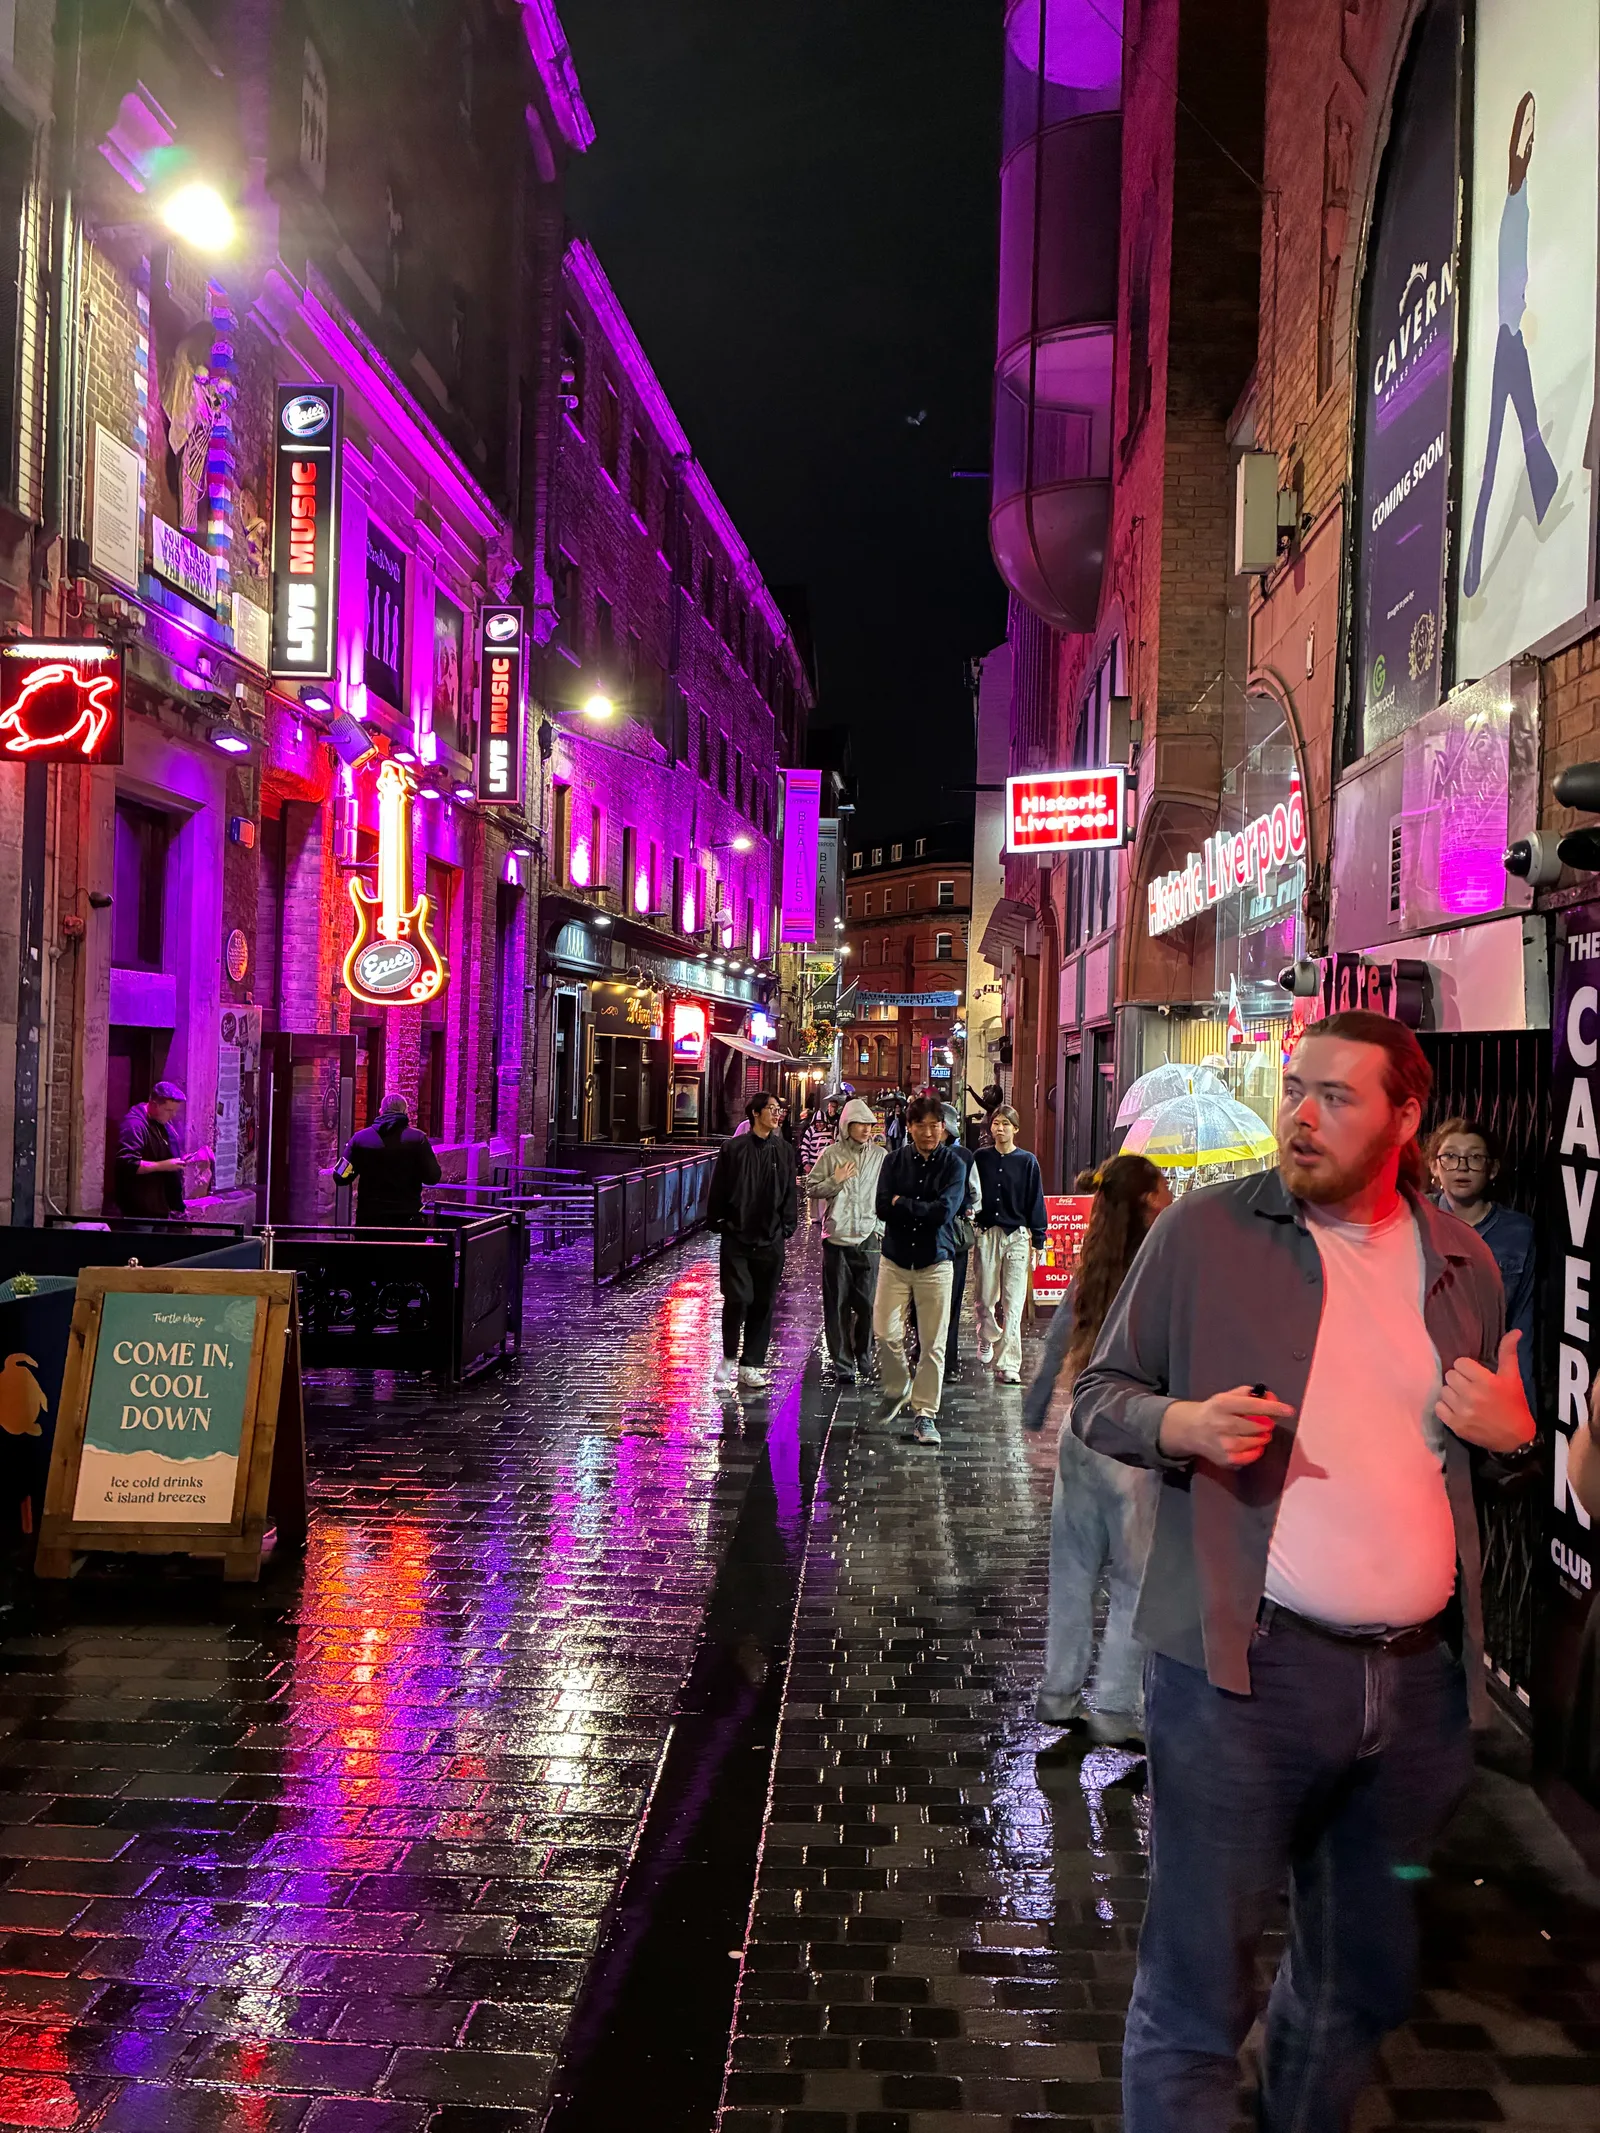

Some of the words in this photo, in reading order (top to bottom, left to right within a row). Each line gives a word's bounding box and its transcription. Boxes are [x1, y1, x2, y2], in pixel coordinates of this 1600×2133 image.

[1374, 253, 1453, 396] CAVERN
[1412, 327, 1438, 366] HOTEL
[1372, 470, 1411, 532] COMING
[1412, 431, 1445, 488] SOON
[290, 461, 317, 575] MUSIC
[162, 539, 180, 564] WHO
[184, 554, 212, 590] SHOOK
[164, 526, 185, 554] FOUR
[189, 540, 211, 571] LADS
[287, 583, 317, 662] LIVE
[490, 657, 510, 734] MUSIC
[489, 739, 508, 793] LIVE
[1014, 809, 1115, 834] Liverpool
[1021, 791, 1107, 814] Historic
[795, 811, 806, 902] BEATLES
[1147, 852, 1204, 938] Historic
[1204, 790, 1307, 906] Liverpoo
[818, 852, 827, 929] BEATLES
[363, 949, 413, 984] Eric's
[1568, 931, 1600, 962] THE
[1047, 1223, 1069, 1231] SOFT
[1051, 1214, 1071, 1222] PICK
[1071, 1214, 1083, 1222] UP
[1553, 986, 1598, 1530] CAVERN
[152, 1312, 182, 1324] Turtle
[112, 1341, 196, 1366] COME
[202, 1343, 234, 1370] IN,
[130, 1373, 209, 1399] COOL
[120, 1405, 212, 1432] DOWN
[103, 1491, 113, 1503] &
[117, 1491, 155, 1504] island
[157, 1491, 206, 1504] breezes
[111, 1476, 129, 1488] Ice
[132, 1476, 160, 1488] cold
[163, 1476, 203, 1488] drinks
[1551, 1537, 1592, 1590] CLUB
